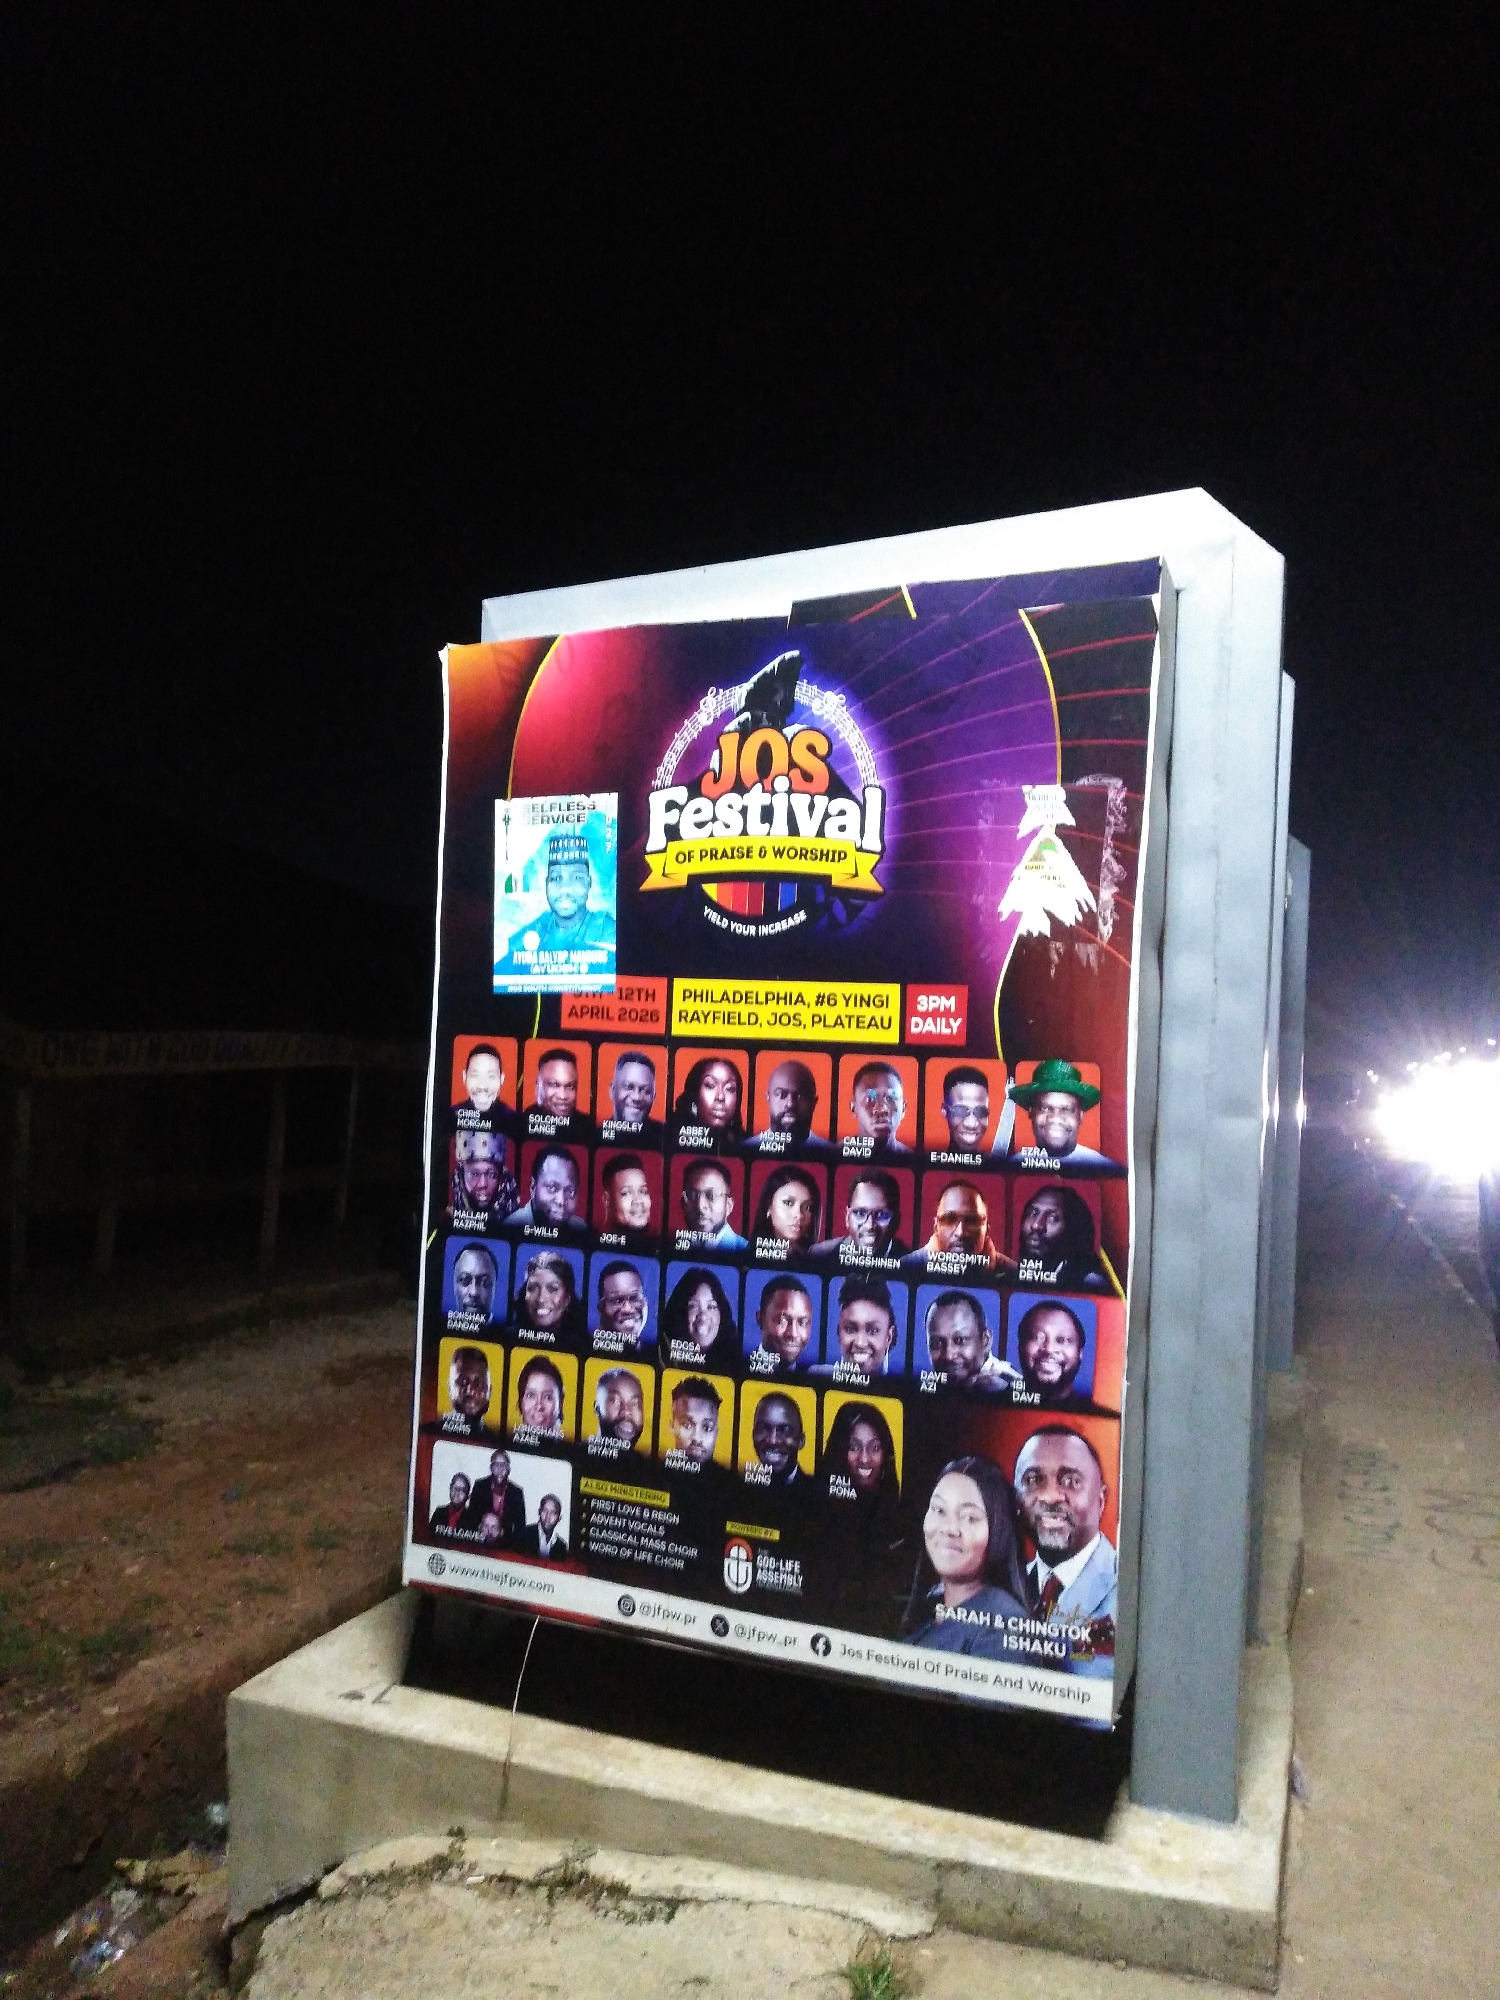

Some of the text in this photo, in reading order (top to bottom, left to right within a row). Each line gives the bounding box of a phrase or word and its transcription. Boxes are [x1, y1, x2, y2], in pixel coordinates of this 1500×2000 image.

[701, 727, 830, 799] JOS
[646, 775, 882, 853] Festival
[675, 850, 695, 864] OF
[700, 846, 753, 861] PRAISE
[772, 846, 847, 863] WORSHIP
[703, 905, 807, 937] YIELD YOUR INCREASE
[617, 987, 656, 1002] 12TH
[682, 988, 890, 1009] PHILADELPHIA, #6 YINGI
[917, 995, 956, 1013] 3PM
[568, 1005, 660, 1022] APRIL 2026
[678, 1010, 892, 1030] RAYFIELD, JOS, PLATEAU
[910, 1017, 963, 1035] DAILY
[457, 1109, 481, 1119] CHRIS
[528, 1114, 570, 1127] SOLOMON
[457, 1118, 492, 1129] MORGAN
[528, 1125, 556, 1135] LANGE
[602, 1120, 644, 1133] KINGSLEY
[602, 1130, 616, 1140] IKE
[679, 1126, 710, 1137] ABBEY
[760, 1131, 792, 1143] MOSES
[678, 1136, 714, 1148] OJOMU
[759, 1142, 785, 1152] AKOH
[843, 1136, 874, 1147] CALEB
[843, 1147, 872, 1157] DAVID
[931, 1152, 982, 1165] E-DANIELS
[1021, 1147, 1048, 1157] EZRA
[1021, 1157, 1061, 1169] JINANG
[454, 1210, 488, 1221] MALLAM
[524, 1225, 559, 1238] G-WILLS
[756, 1248, 787, 1260] BANDE
[840, 1244, 872, 1255] POLITE
[927, 1252, 990, 1265] WORDSMITH
[1020, 1259, 1043, 1269] JAH
[927, 1262, 967, 1274] BASSEY
[1019, 1269, 1057, 1283] DEVICE
[519, 1328, 556, 1343] PHILIPPA
[750, 1351, 781, 1363] JOSES
[750, 1362, 774, 1374] JACK
[833, 1360, 861, 1373] ANNA
[832, 1372, 870, 1385] ISIYAKU
[920, 1370, 948, 1383] DAVE
[920, 1382, 937, 1393] AZI
[1013, 1380, 1026, 1391] IBI
[1012, 1391, 1041, 1404] DAVE
[591, 1498, 616, 1513] FIRST
[618, 1502, 641, 1517] LOVE
[652, 1510, 680, 1525] REIGN
[590, 1513, 665, 1537] ADVENT VOCALS
[589, 1527, 698, 1559] CLASSICAL MASS CHOIR
[589, 1541, 685, 1571] WORD OF LIFE CHOIR
[449, 1563, 555, 1594] www.thejfpw.com
[756, 1569, 803, 1587] ASSEMBLY
[935, 1603, 1092, 1643] SARAH & CHINGTOK
[1003, 1633, 1066, 1659] ISHAKU
[840, 1644, 1092, 1704] Jos Festival Of Praise And Worship
